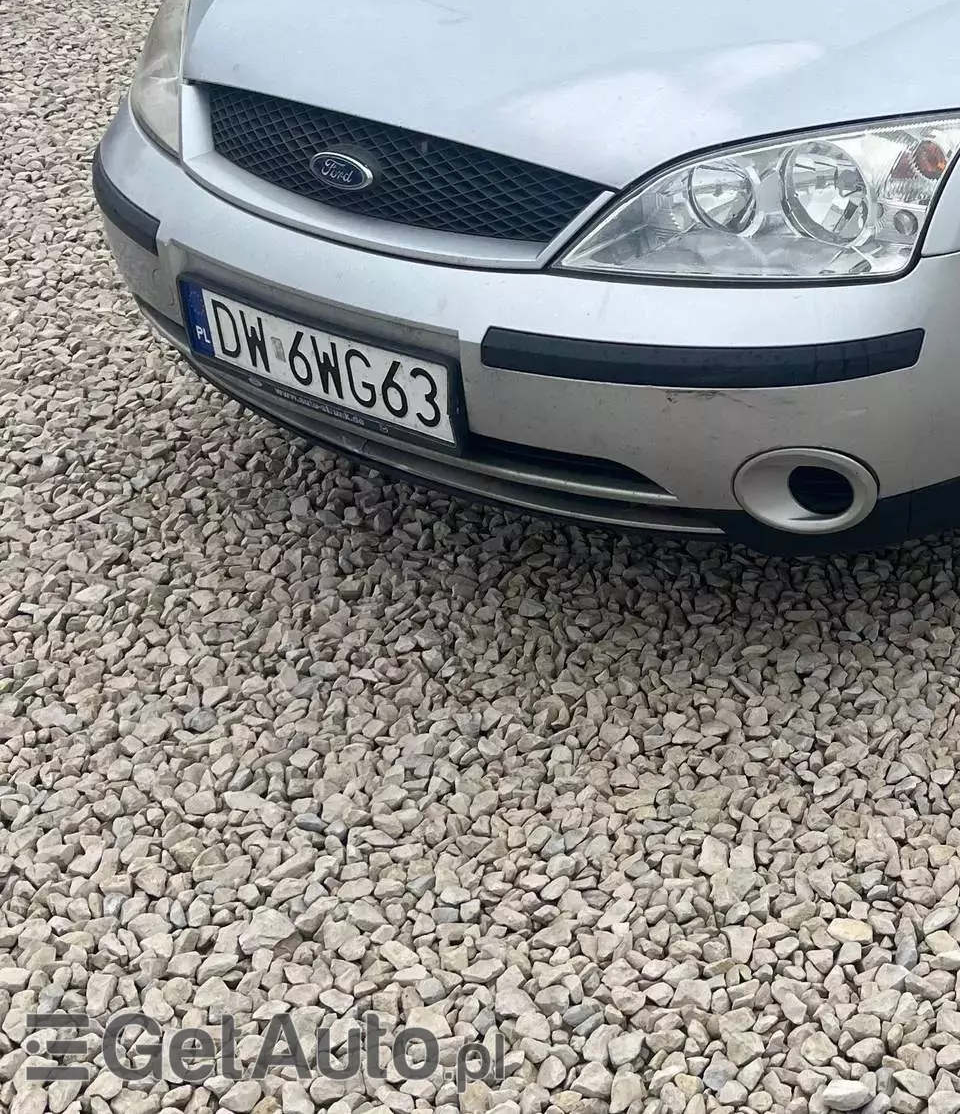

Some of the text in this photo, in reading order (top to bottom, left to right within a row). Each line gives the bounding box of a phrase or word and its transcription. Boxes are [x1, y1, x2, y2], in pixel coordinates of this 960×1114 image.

[321, 158, 354, 183] Ford
[195, 325, 211, 345] PL
[211, 298, 441, 428] DW 6WG63
